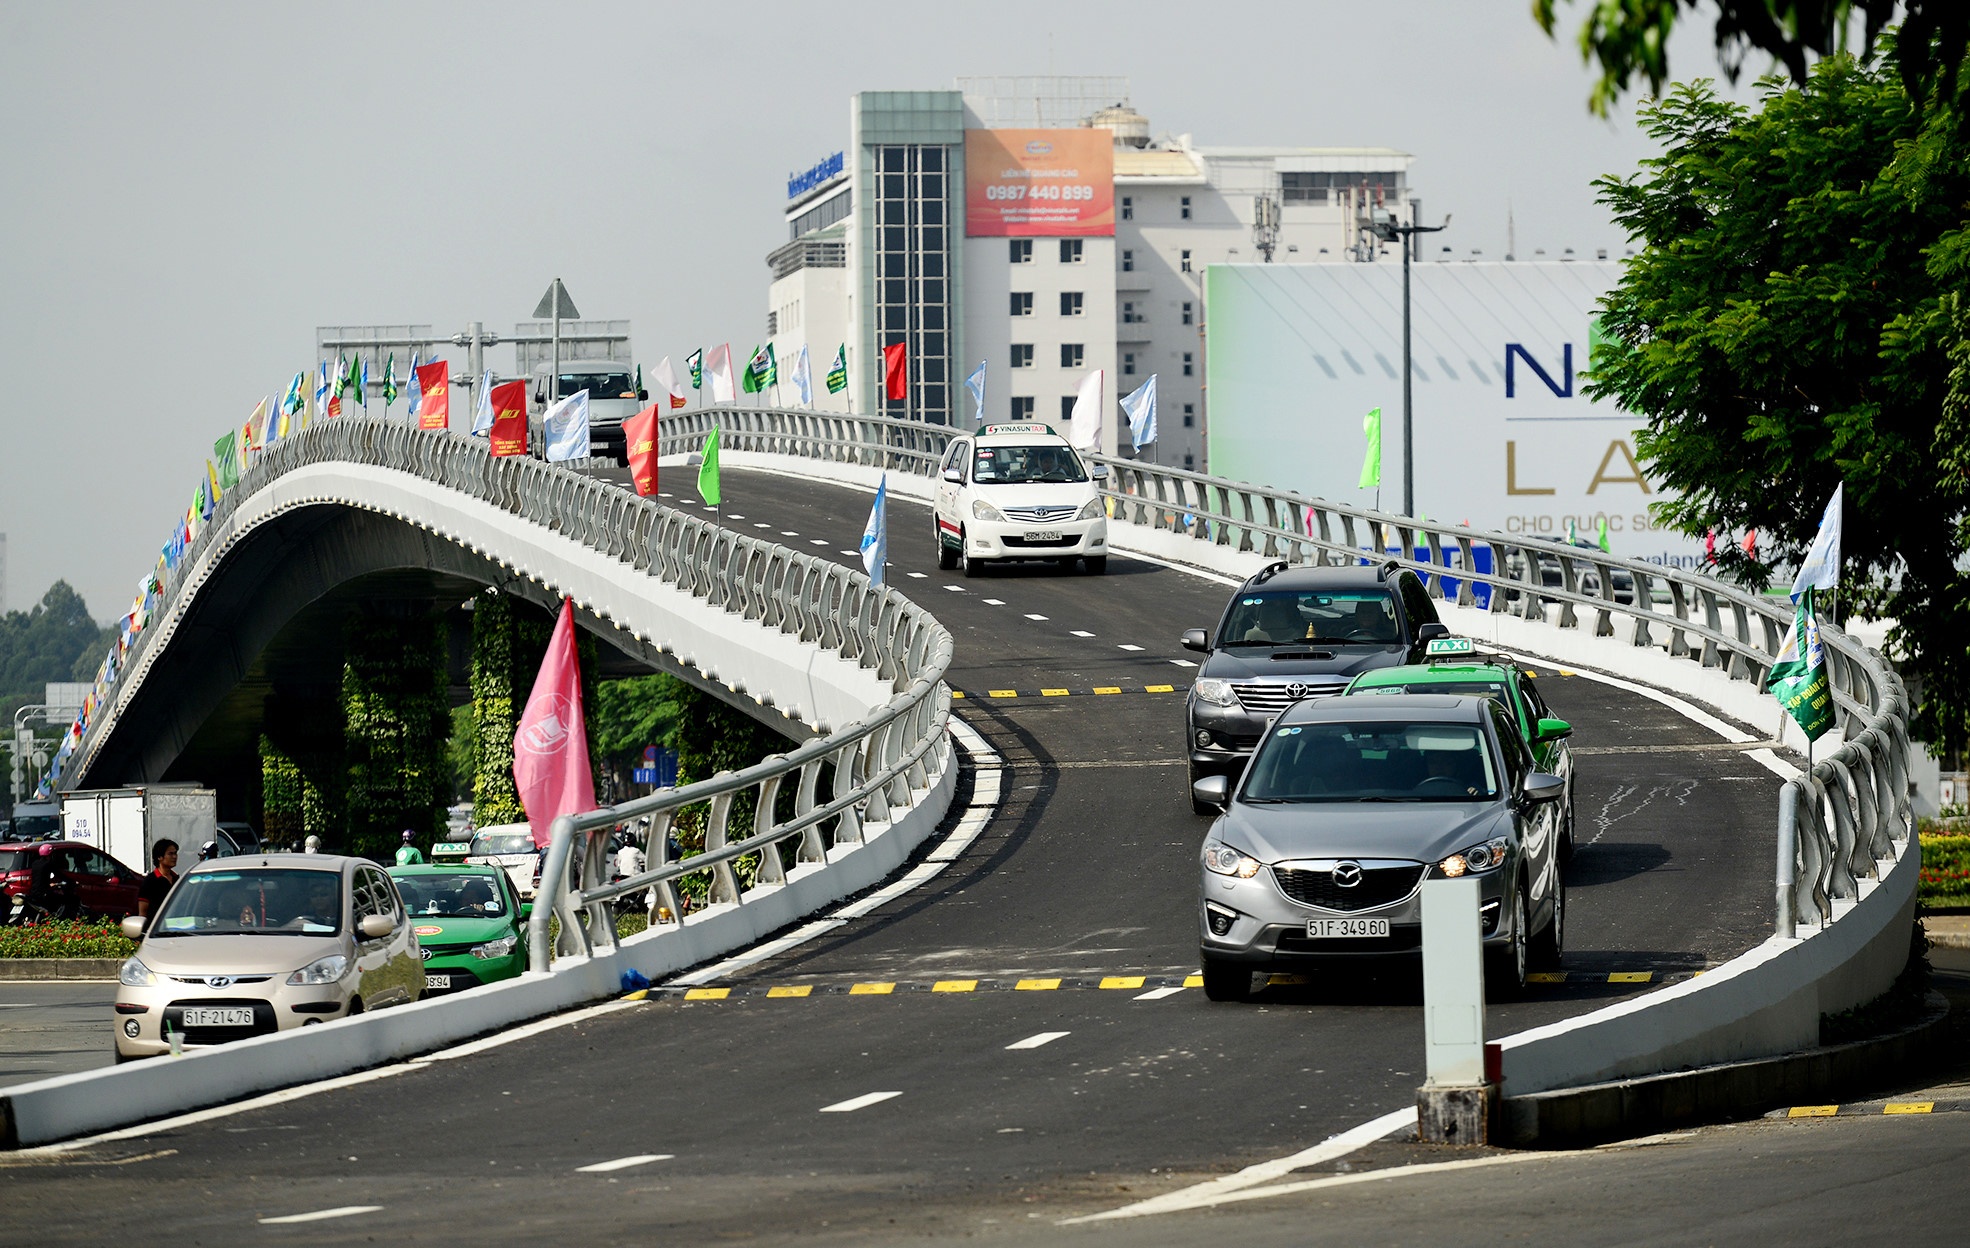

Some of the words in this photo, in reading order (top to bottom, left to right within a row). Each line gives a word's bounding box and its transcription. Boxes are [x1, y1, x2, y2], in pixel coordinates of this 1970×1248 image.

[986, 185, 1028, 200] 0987
[1029, 185, 1060, 200] 440
[1062, 185, 1093, 200] 899
[1506, 515, 1553, 533] CHO
[1309, 920, 1387, 936] 51F-349.60
[185, 1010, 251, 1024] 51F-214.76
